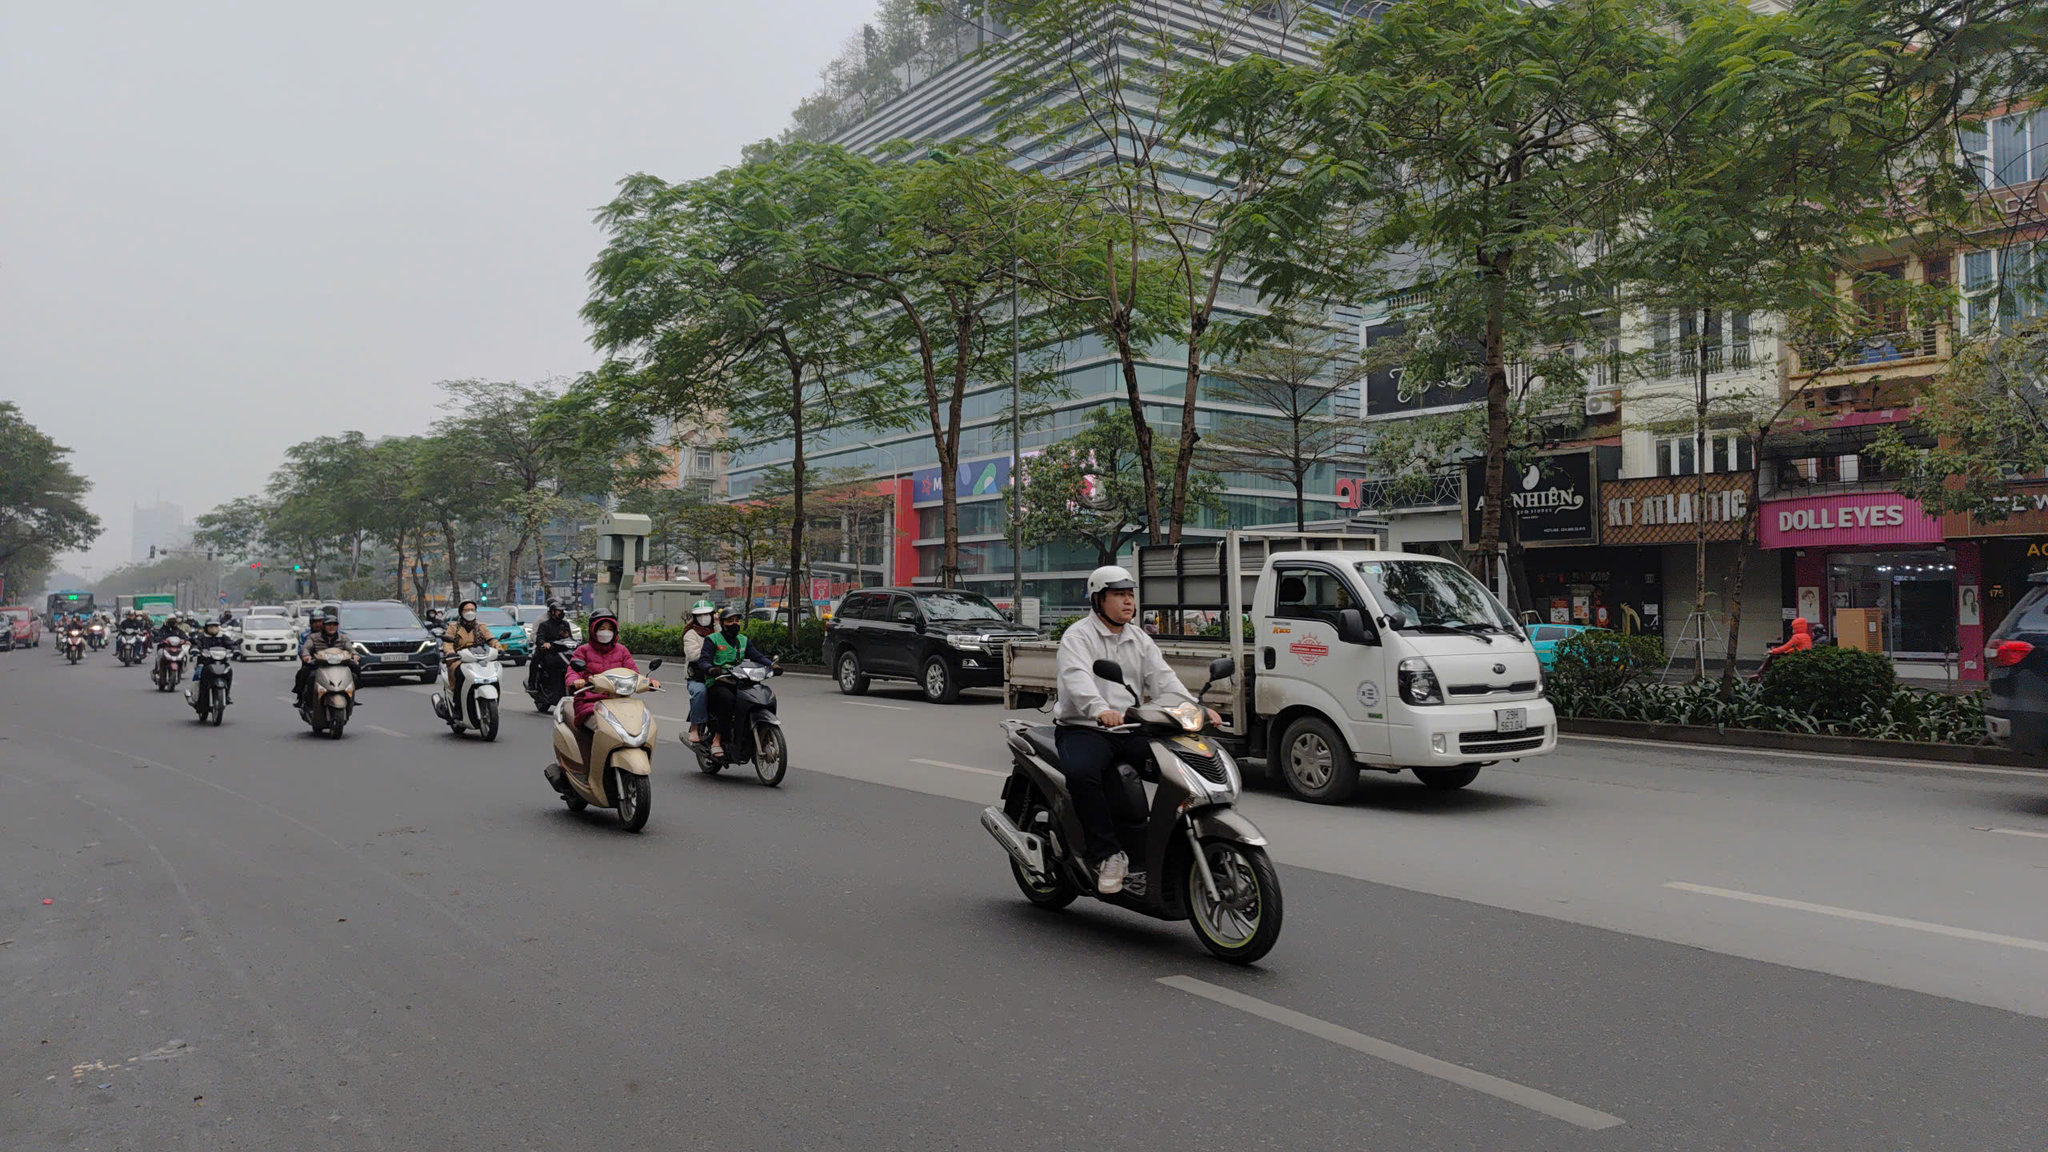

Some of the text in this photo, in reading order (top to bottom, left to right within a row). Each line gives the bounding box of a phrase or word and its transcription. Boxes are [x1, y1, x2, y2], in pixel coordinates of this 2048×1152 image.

[1511, 486, 1577, 508] NHIÊN
[1608, 489, 1747, 526] KT ATLANTIC
[1779, 505, 1904, 531] DOLL EYES
